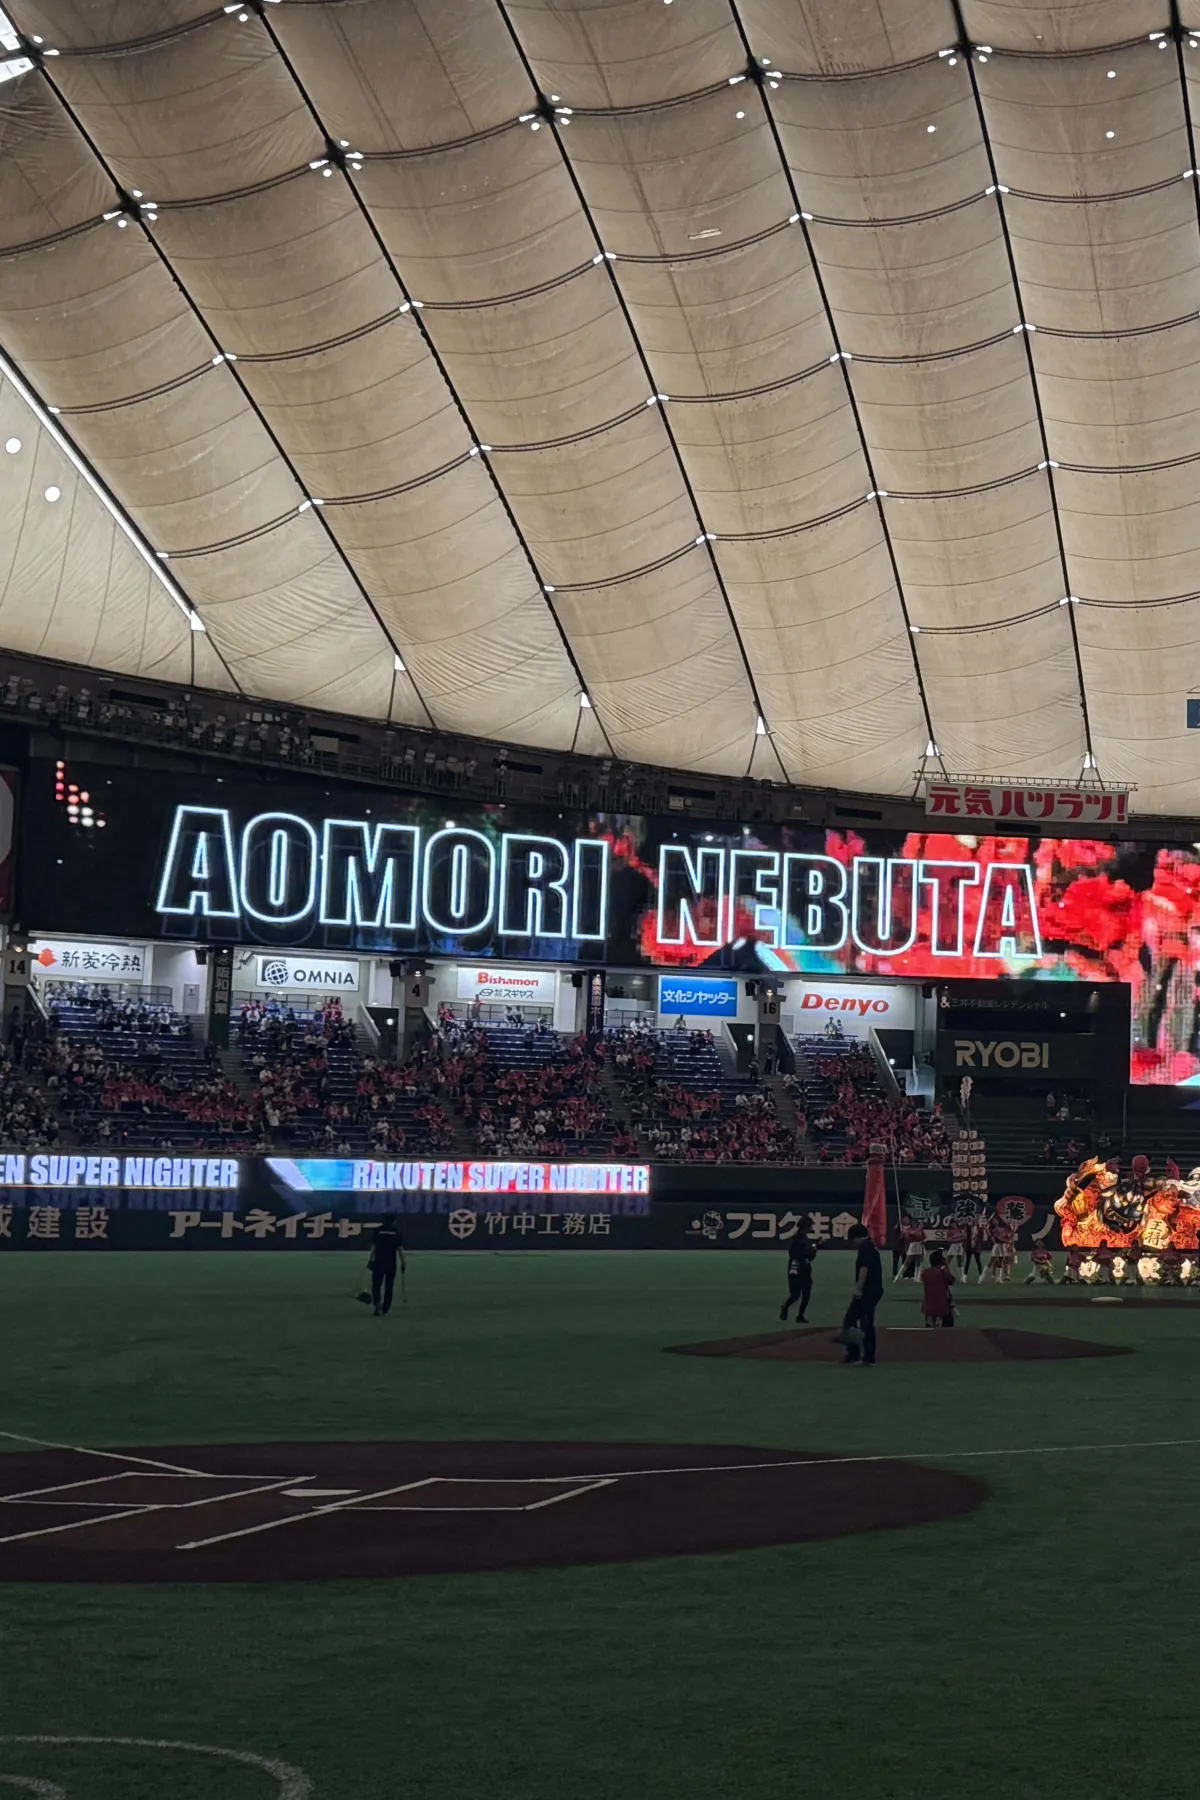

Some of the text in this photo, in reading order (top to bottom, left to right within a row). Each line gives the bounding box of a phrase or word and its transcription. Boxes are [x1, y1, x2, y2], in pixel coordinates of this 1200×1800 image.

[155, 804, 1043, 960] AOMORI NEBUTA
[9, 960, 26, 975] 14
[61, 951, 141, 972] 新菱冷熱
[294, 970, 355, 985] OMNIA
[477, 972, 539, 987] Bishamon
[411, 984, 420, 998] 4
[762, 1002, 776, 1015] 16
[800, 993, 890, 1017] Denyo
[954, 1040, 1049, 1069] RYOBI
[30, 1154, 119, 1186] SUPER
[124, 1157, 239, 1188] NIGHTER
[353, 1162, 649, 1193] RAKUTEN SUPER NIGHTER
[168, 1208, 384, 1239] アートネイチャー
[484, 1211, 612, 1236] 竹中工務店
